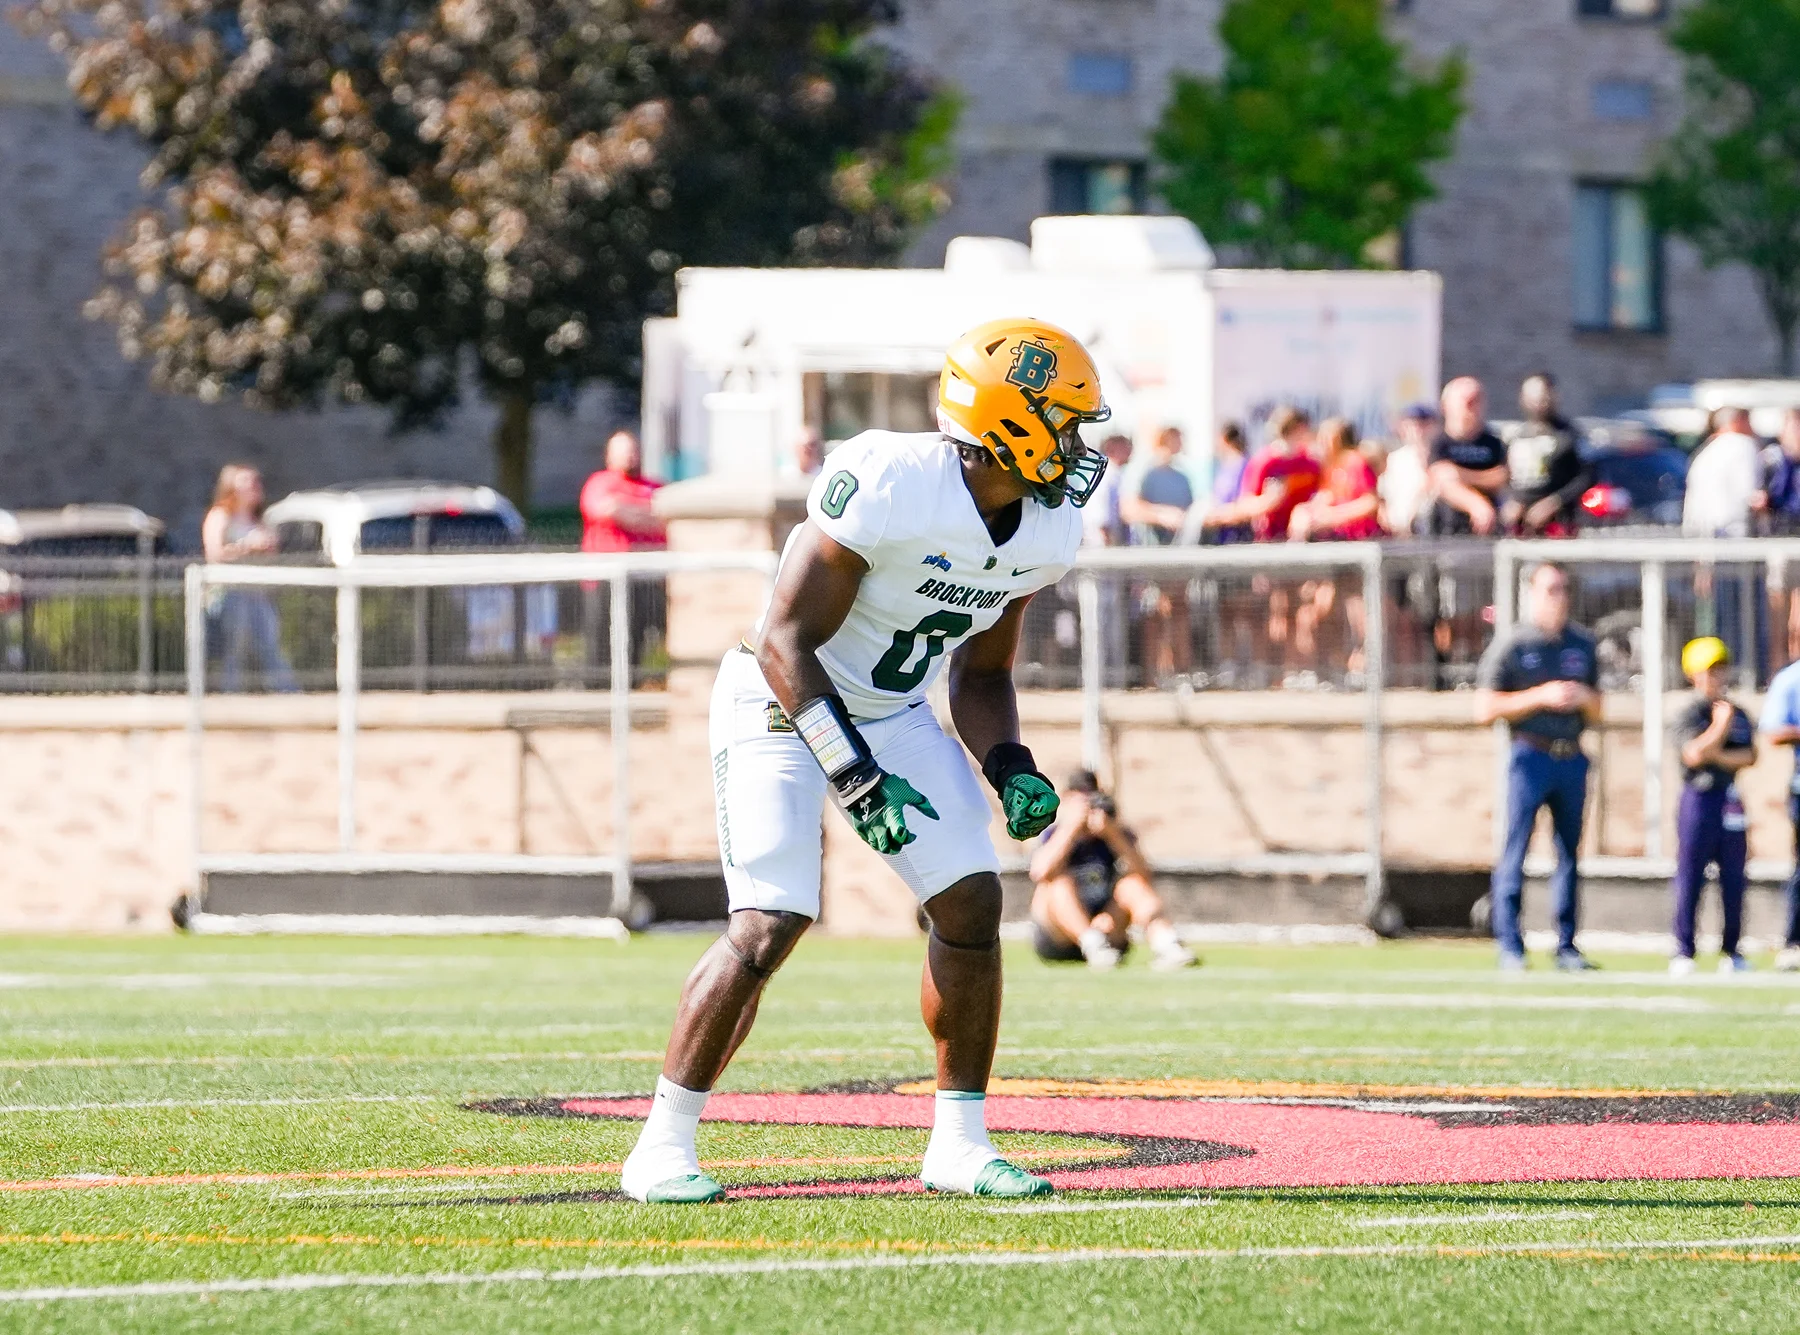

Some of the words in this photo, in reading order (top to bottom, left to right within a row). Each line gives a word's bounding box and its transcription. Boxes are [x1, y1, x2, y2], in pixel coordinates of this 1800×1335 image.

[1005, 340, 1057, 393] B
[820, 469, 859, 519] 0
[915, 578, 1010, 609] BROCKPORT
[871, 609, 973, 693] 0
